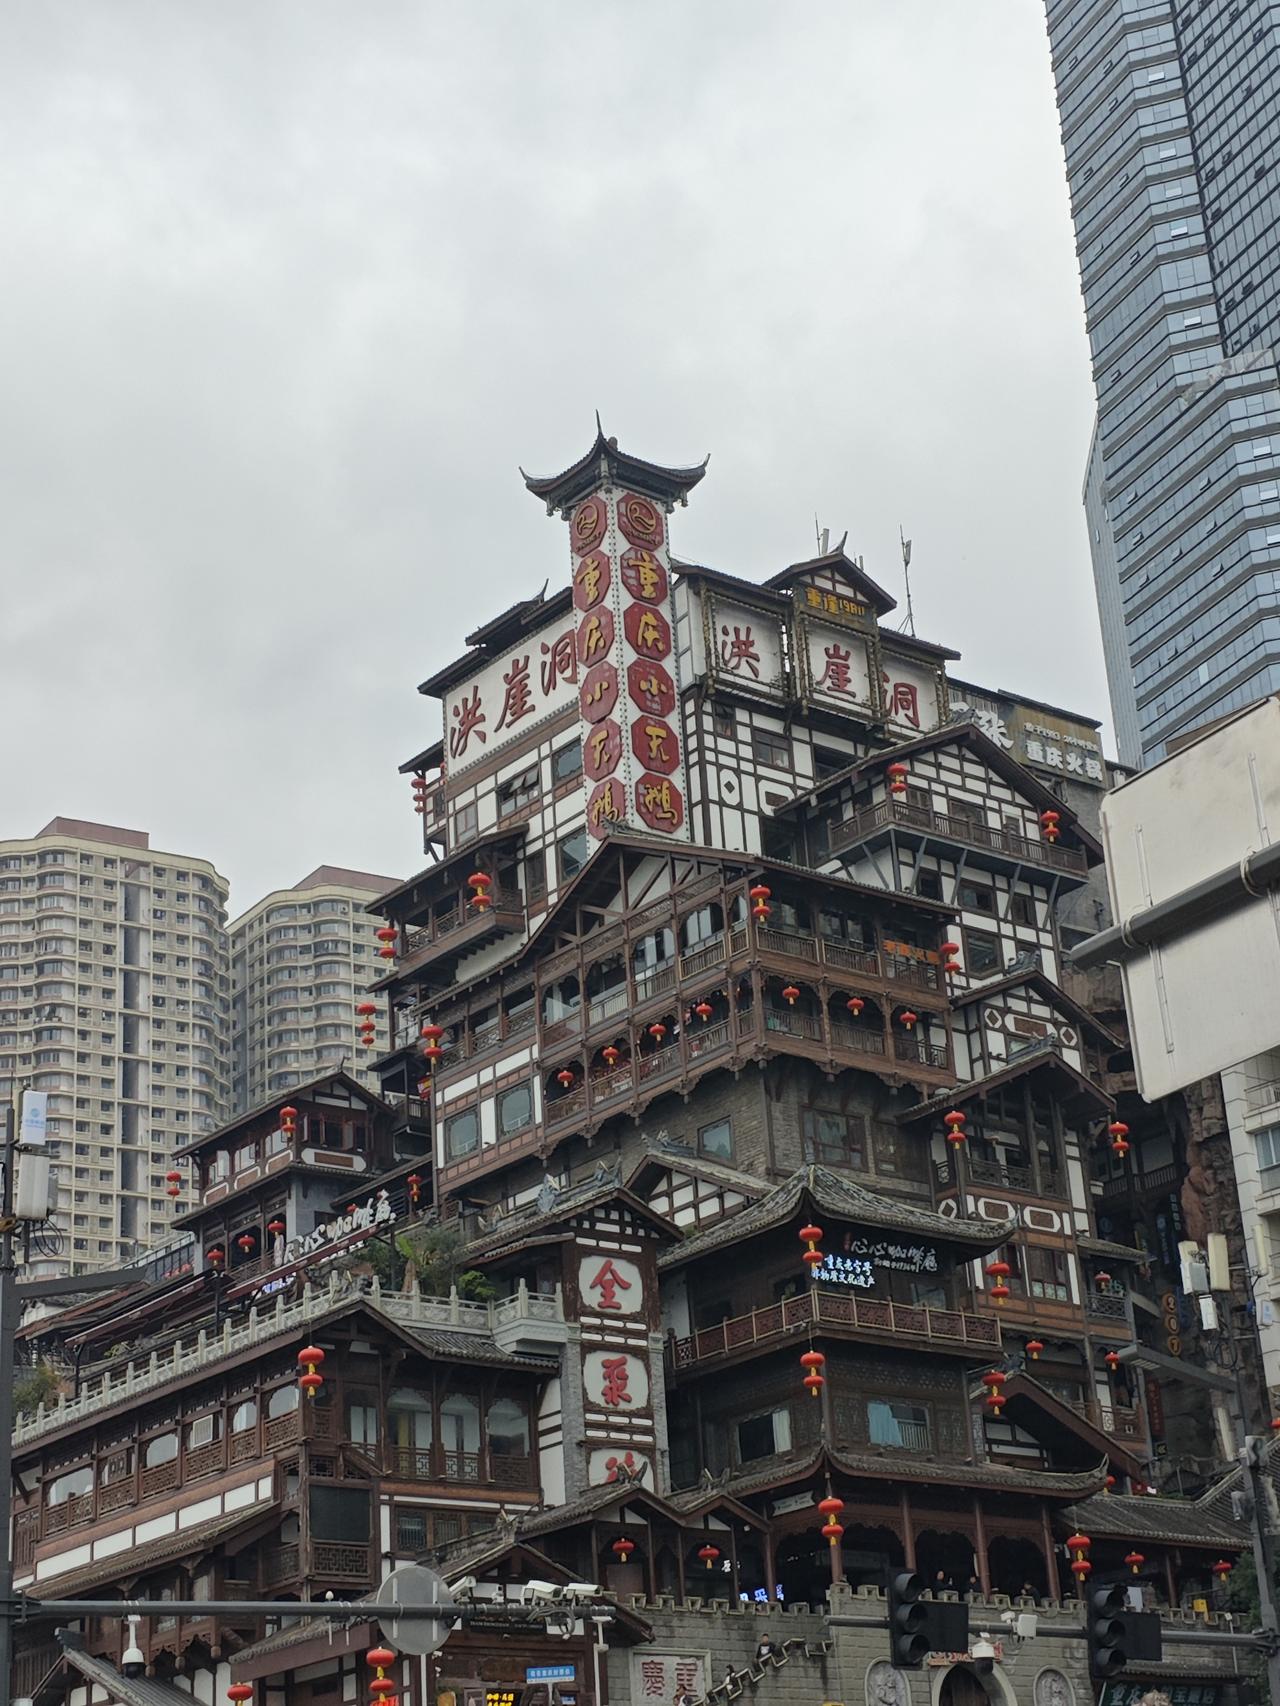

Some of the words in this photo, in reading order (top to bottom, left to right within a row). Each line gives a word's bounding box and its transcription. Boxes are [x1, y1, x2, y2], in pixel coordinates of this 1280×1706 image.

[449, 628, 578, 759] 洪崖洞
[576, 557, 625, 829] 重庆小天鹅
[627, 552, 677, 825] 重庆小天鹅
[720, 625, 921, 728] 洪崖洞
[1025, 739, 1103, 782] 重庆火锅
